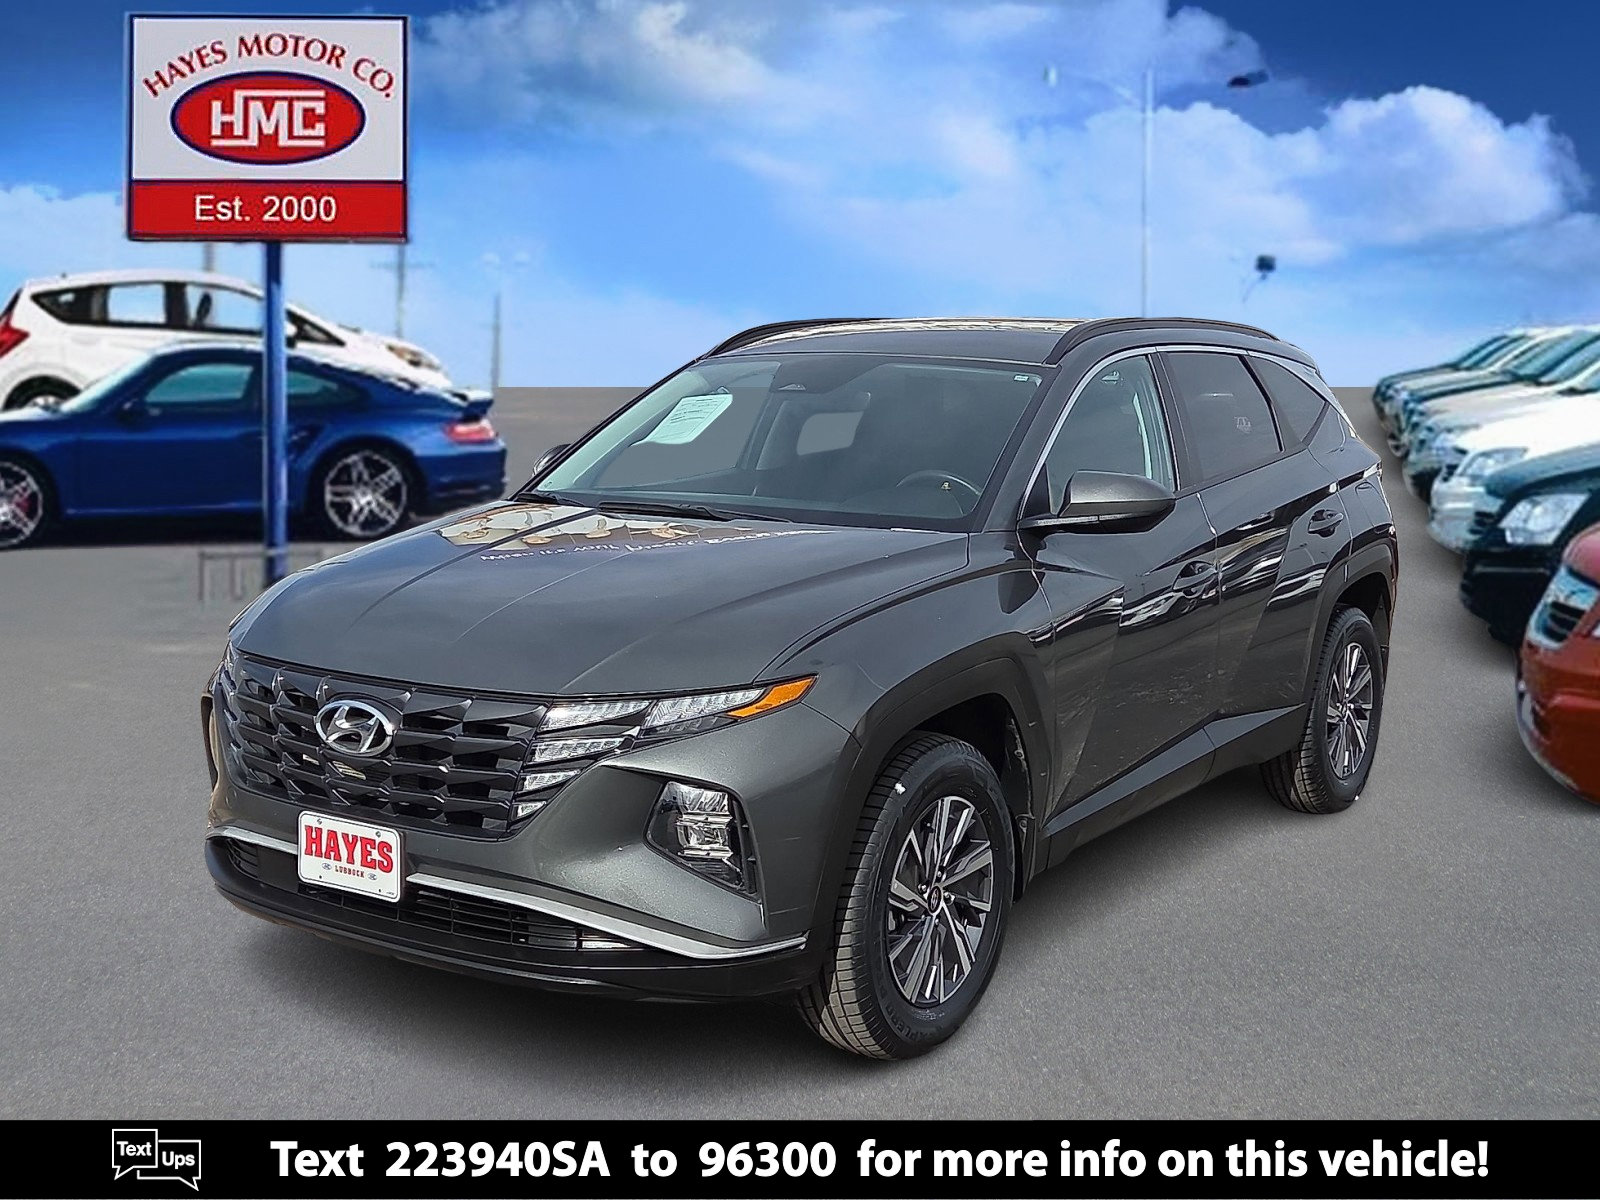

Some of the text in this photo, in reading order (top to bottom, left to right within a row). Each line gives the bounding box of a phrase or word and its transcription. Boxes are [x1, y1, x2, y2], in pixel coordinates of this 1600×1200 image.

[143, 32, 395, 99] HAYES MOTOR CO.
[210, 88, 326, 148] HMC
[194, 194, 337, 222] Est. 2000
[304, 824, 394, 874] HAYES
